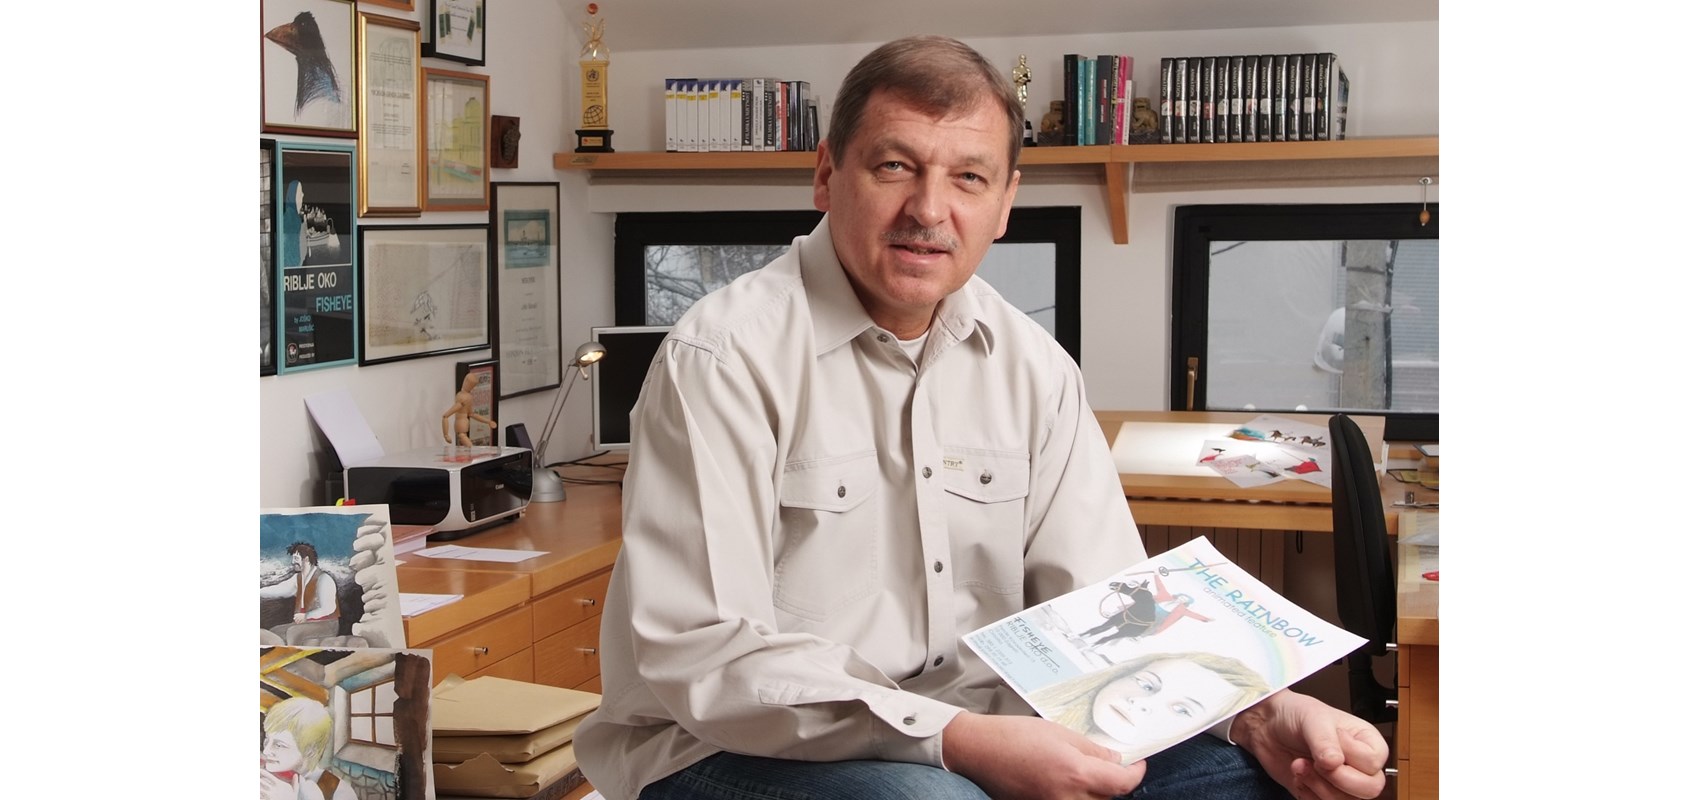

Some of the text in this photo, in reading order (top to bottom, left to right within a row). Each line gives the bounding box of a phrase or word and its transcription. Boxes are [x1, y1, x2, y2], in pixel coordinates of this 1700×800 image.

[284, 272, 337, 292] RIBLJE OKO
[316, 294, 352, 312] FISHEYE
[1189, 557, 1324, 647] THE RAINBOW
[1203, 587, 1278, 638] animated feature
[1007, 621, 1026, 641] RIBLJE
[1014, 616, 1053, 654] FISHEYE
